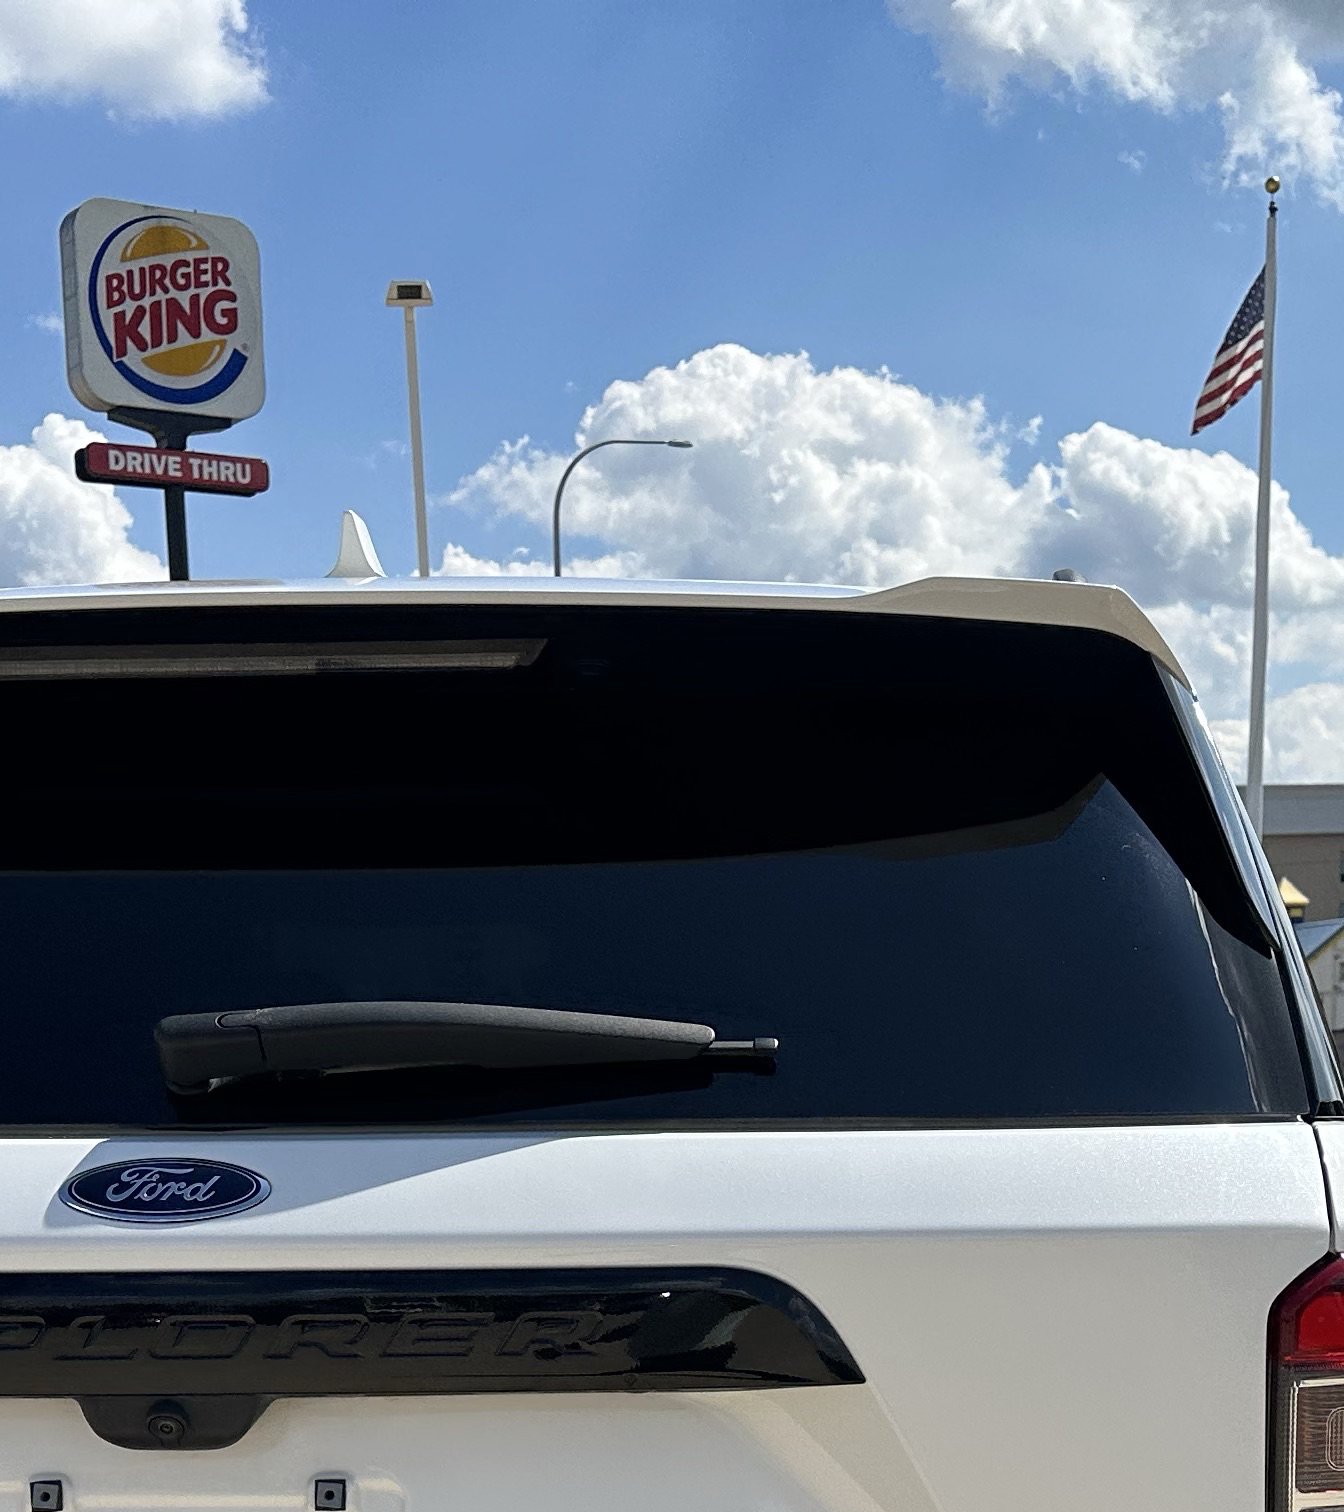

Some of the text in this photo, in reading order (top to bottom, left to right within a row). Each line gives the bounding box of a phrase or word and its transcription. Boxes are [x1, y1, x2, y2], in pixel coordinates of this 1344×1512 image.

[106, 256, 233, 310] BURGER
[112, 288, 239, 360] KING
[109, 449, 252, 485] DRIVE THRU
[105, 1166, 222, 1202] Ford
